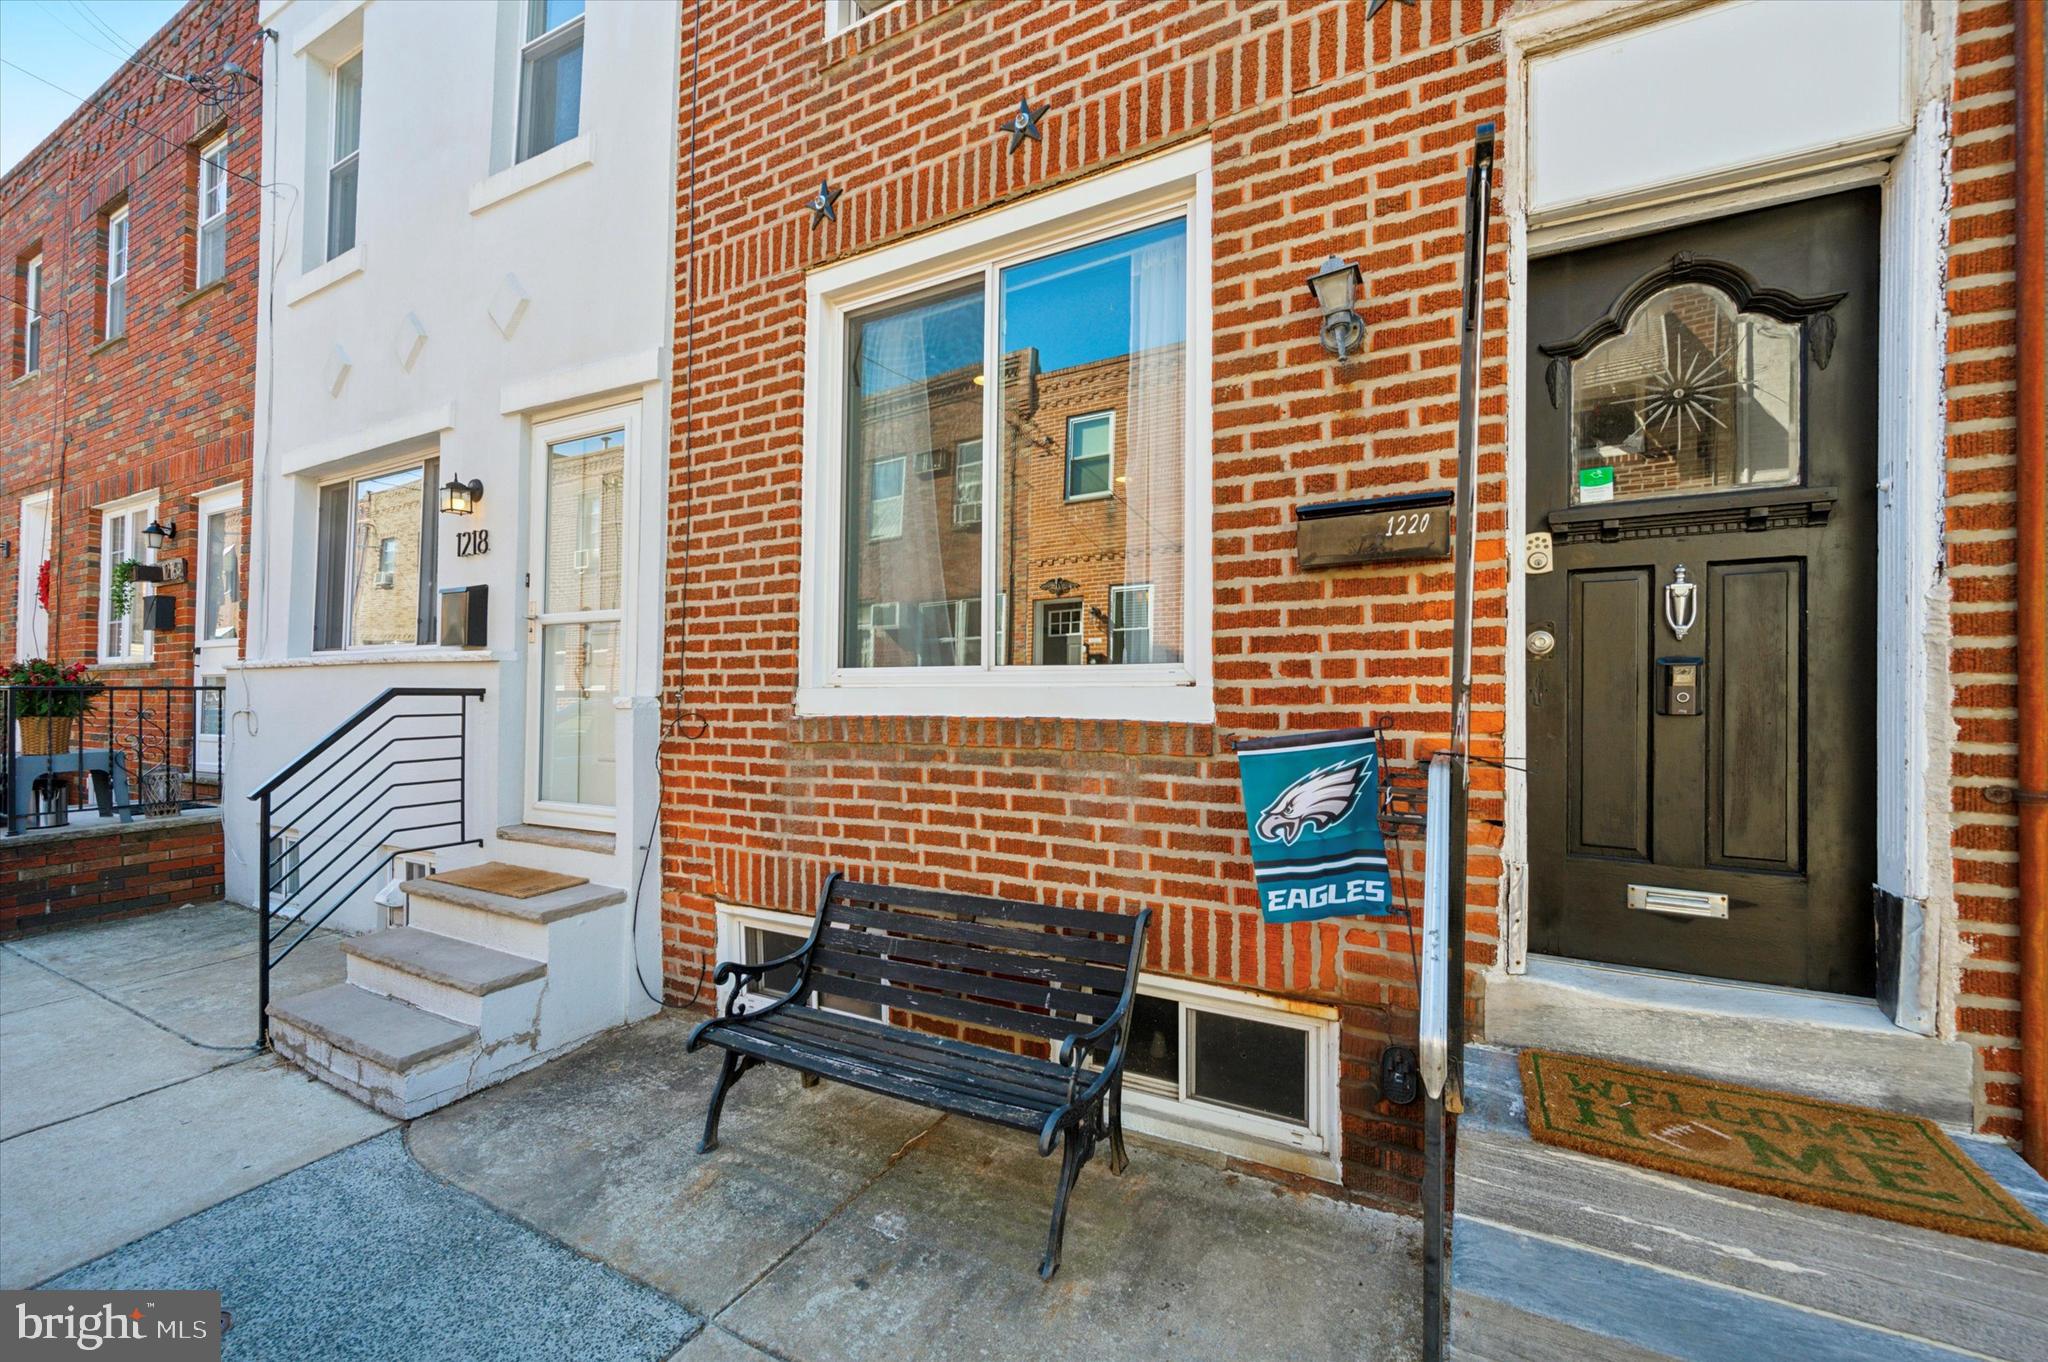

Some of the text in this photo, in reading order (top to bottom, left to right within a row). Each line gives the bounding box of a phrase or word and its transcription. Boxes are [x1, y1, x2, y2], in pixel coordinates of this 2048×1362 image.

[1385, 513, 1430, 536] 1220
[456, 529, 489, 557] 1218
[1267, 880, 1385, 912] EAGLES
[1565, 1072, 1918, 1155] WELCOME
